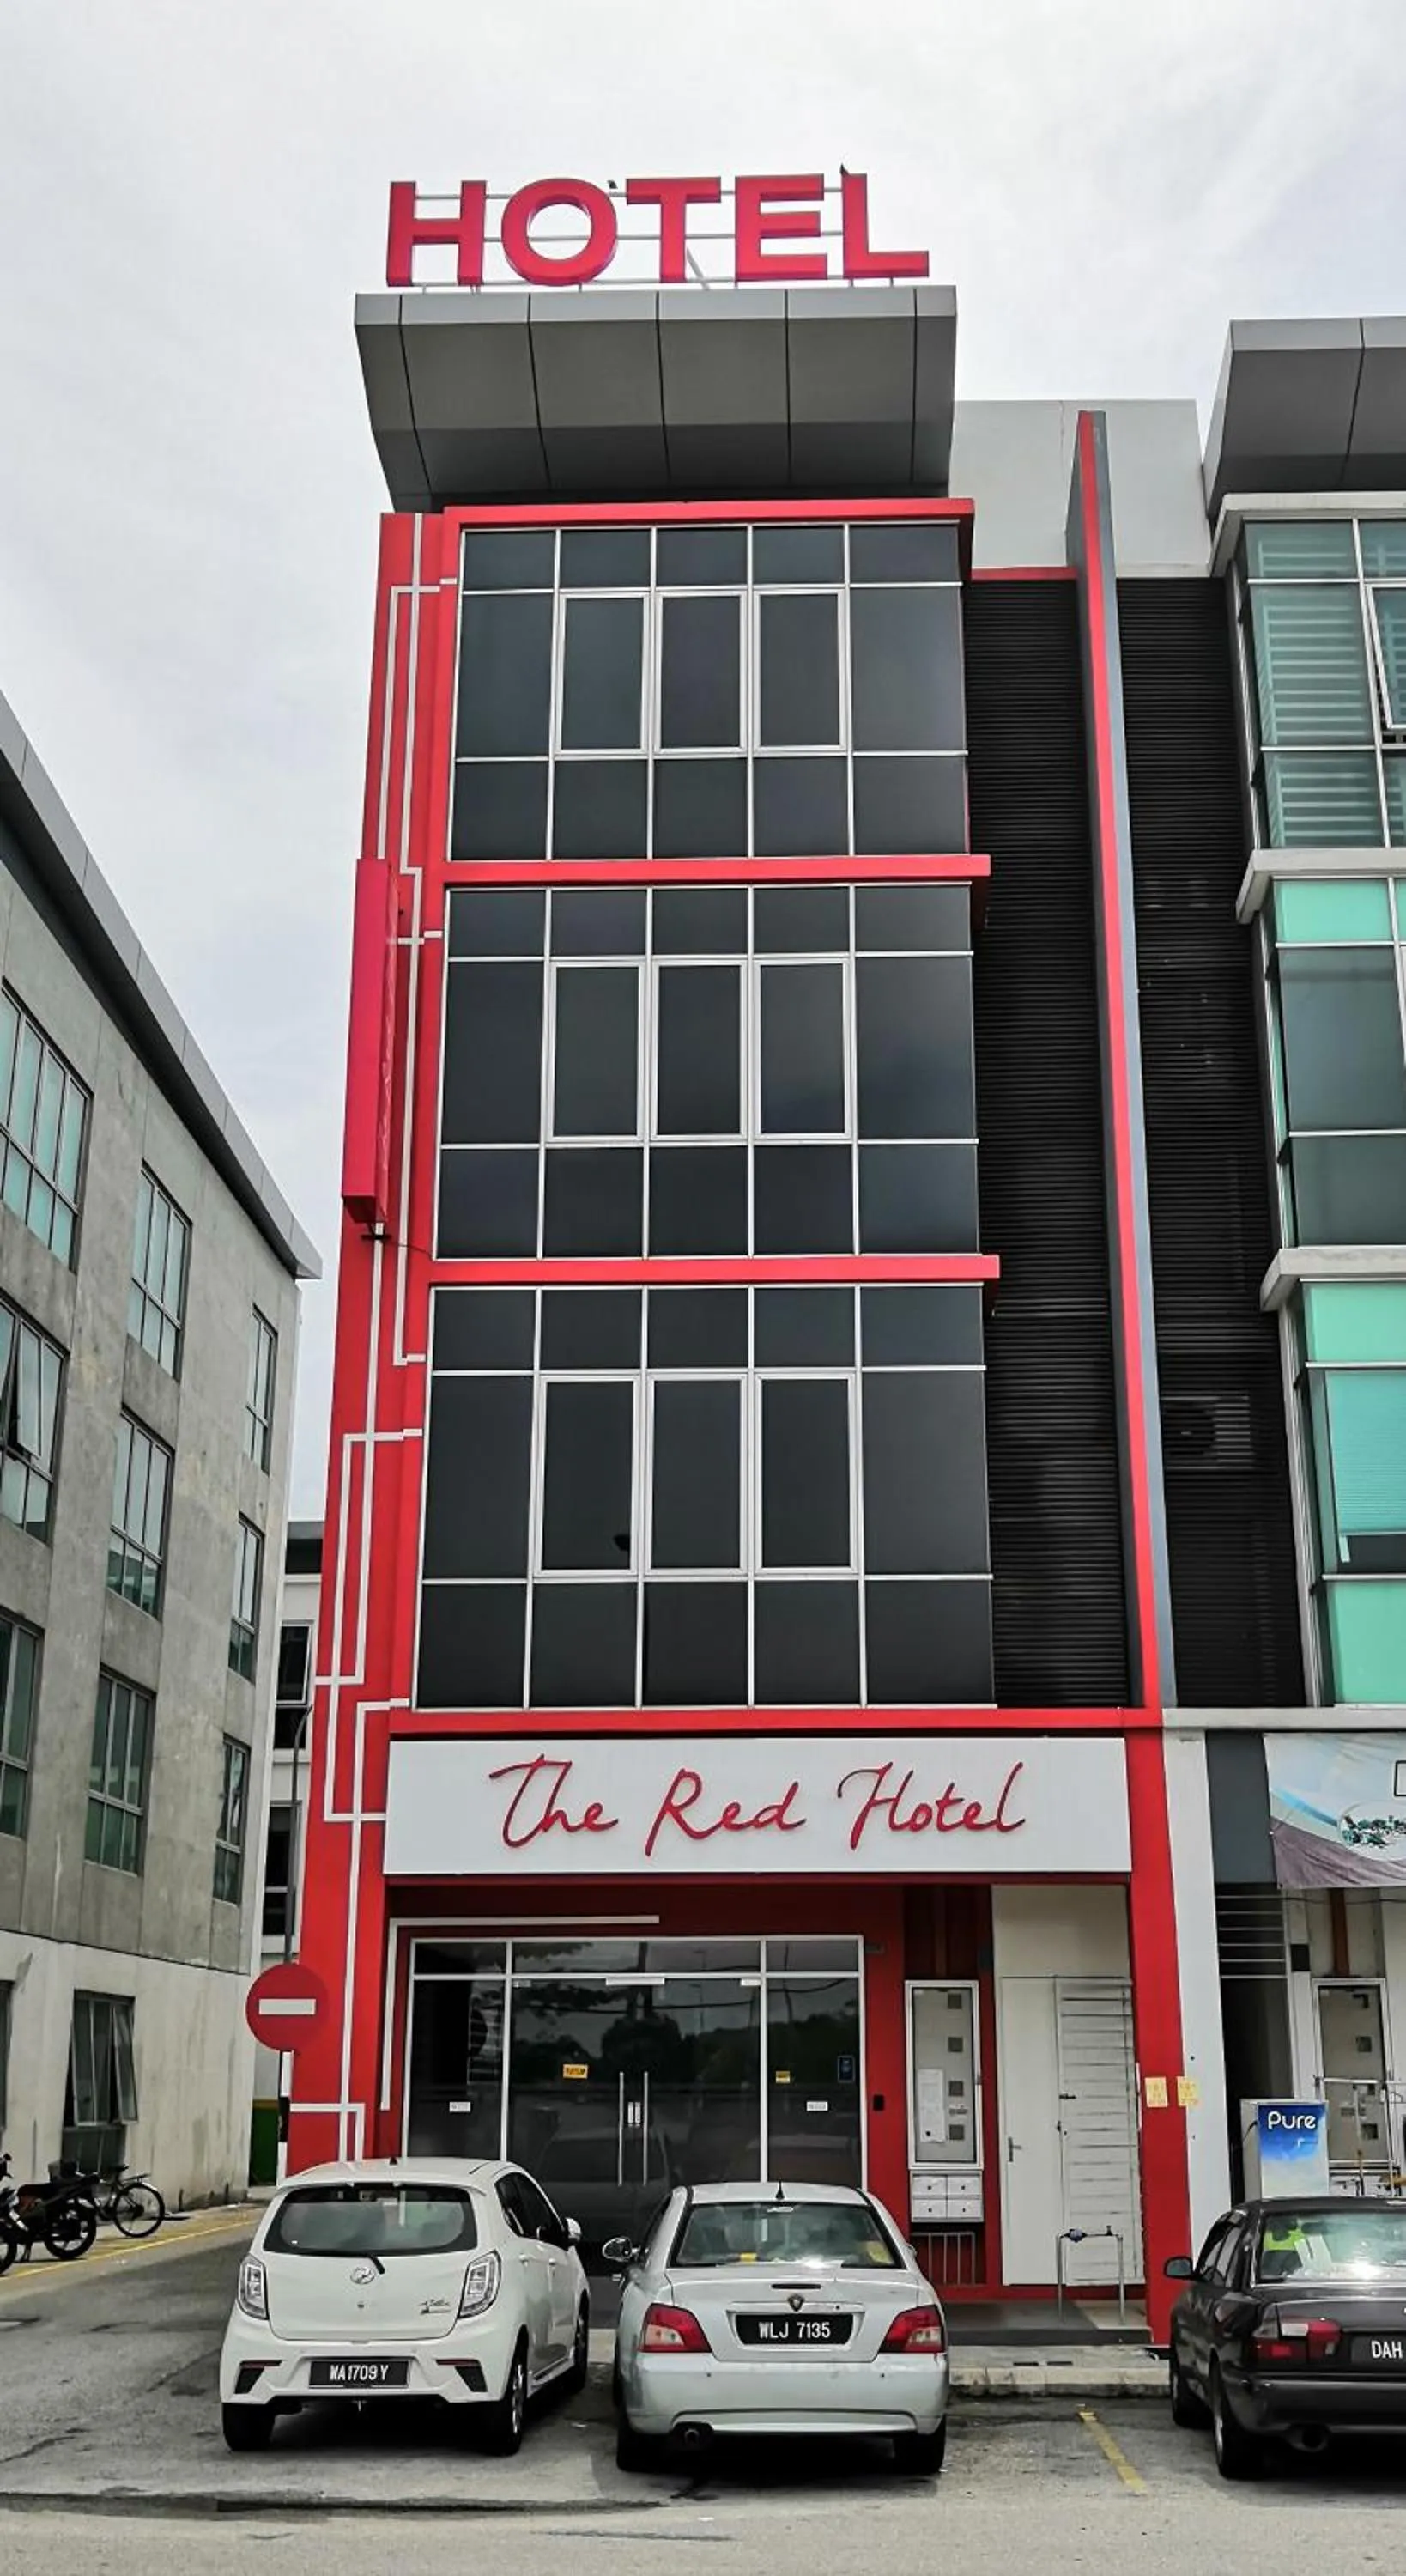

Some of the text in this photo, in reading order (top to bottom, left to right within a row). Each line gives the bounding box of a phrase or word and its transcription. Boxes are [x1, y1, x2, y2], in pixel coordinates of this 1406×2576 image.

[386, 173, 930, 287] HOTEL
[489, 1754, 1025, 1856] The Red Hotel
[1268, 2111, 1316, 2129] Pure
[759, 2322, 830, 2339] WLJ 7135
[1371, 2340, 1403, 2359] DAH
